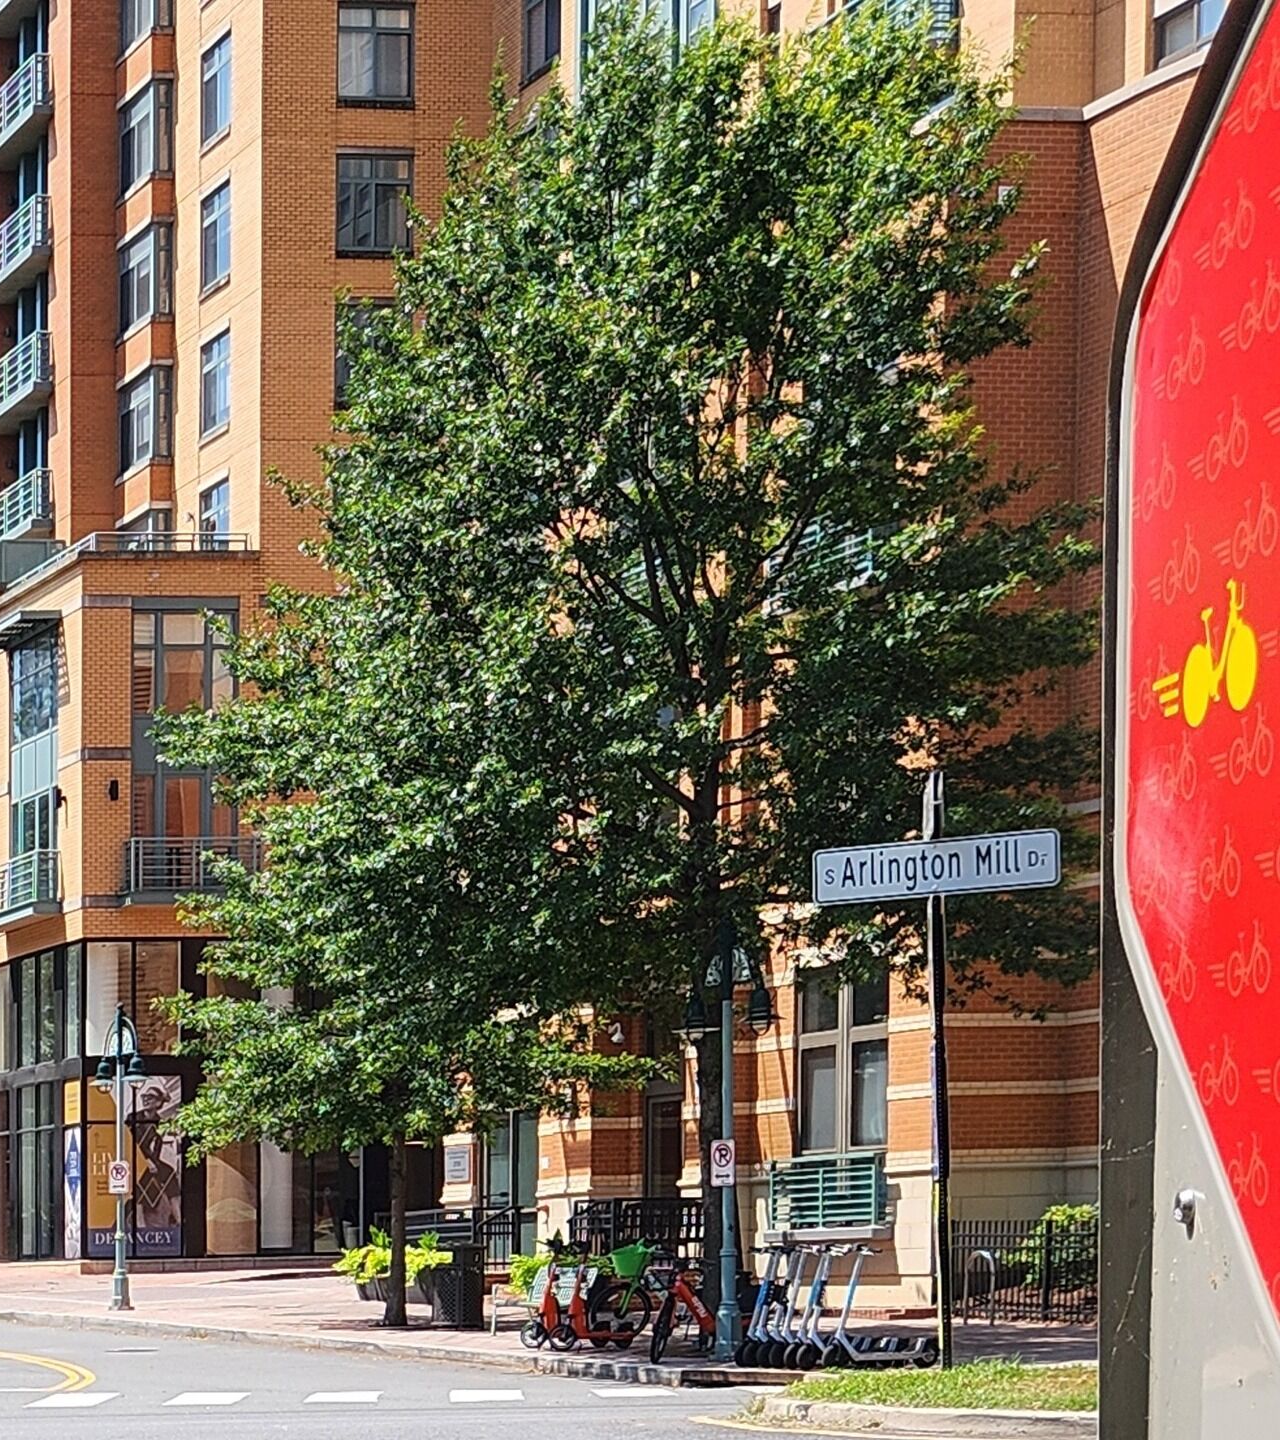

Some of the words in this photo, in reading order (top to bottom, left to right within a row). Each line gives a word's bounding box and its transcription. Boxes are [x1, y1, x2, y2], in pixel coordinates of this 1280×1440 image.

[824, 868, 835, 885] S
[841, 850, 961, 891] Arlington
[975, 839, 1021, 877] Mill
[1028, 851, 1048, 867] Dr
[95, 1231, 173, 1245] DEANCEY
